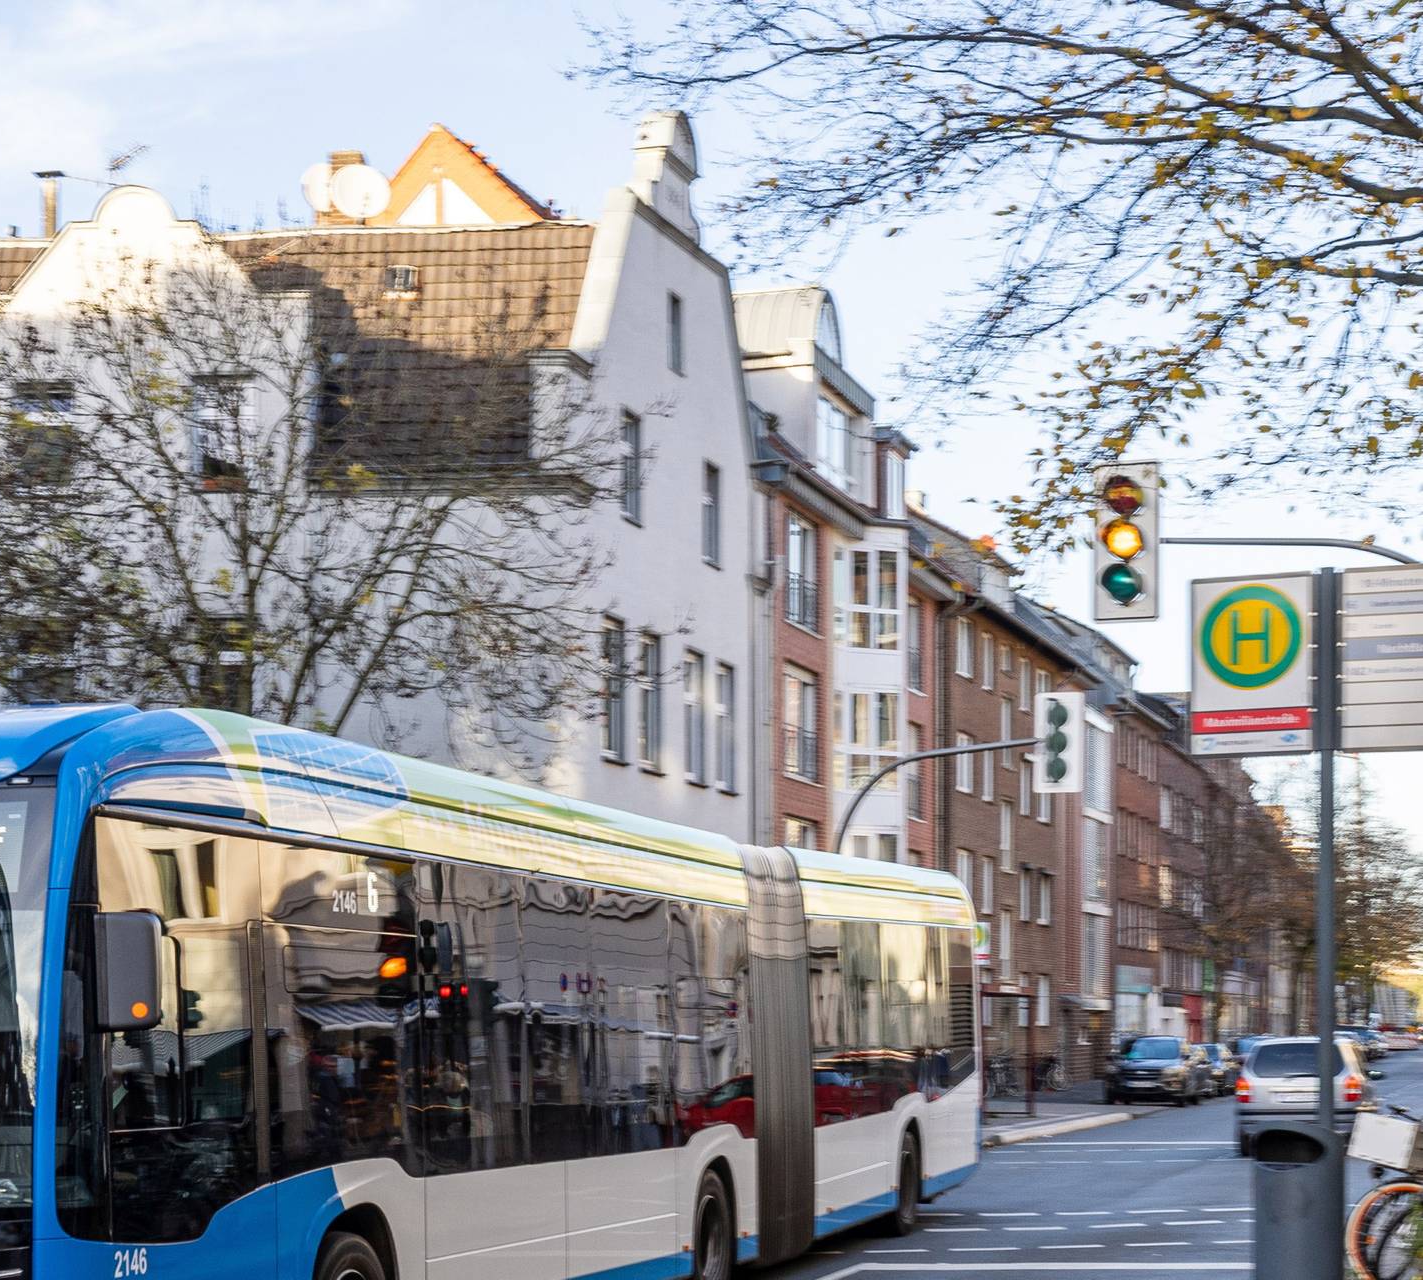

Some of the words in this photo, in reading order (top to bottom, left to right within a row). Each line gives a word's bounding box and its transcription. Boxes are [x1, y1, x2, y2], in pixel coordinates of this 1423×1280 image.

[1230, 607, 1271, 665] H
[332, 890, 357, 914] 2146
[367, 871, 379, 913] 6
[114, 1247, 148, 1279] 2146
